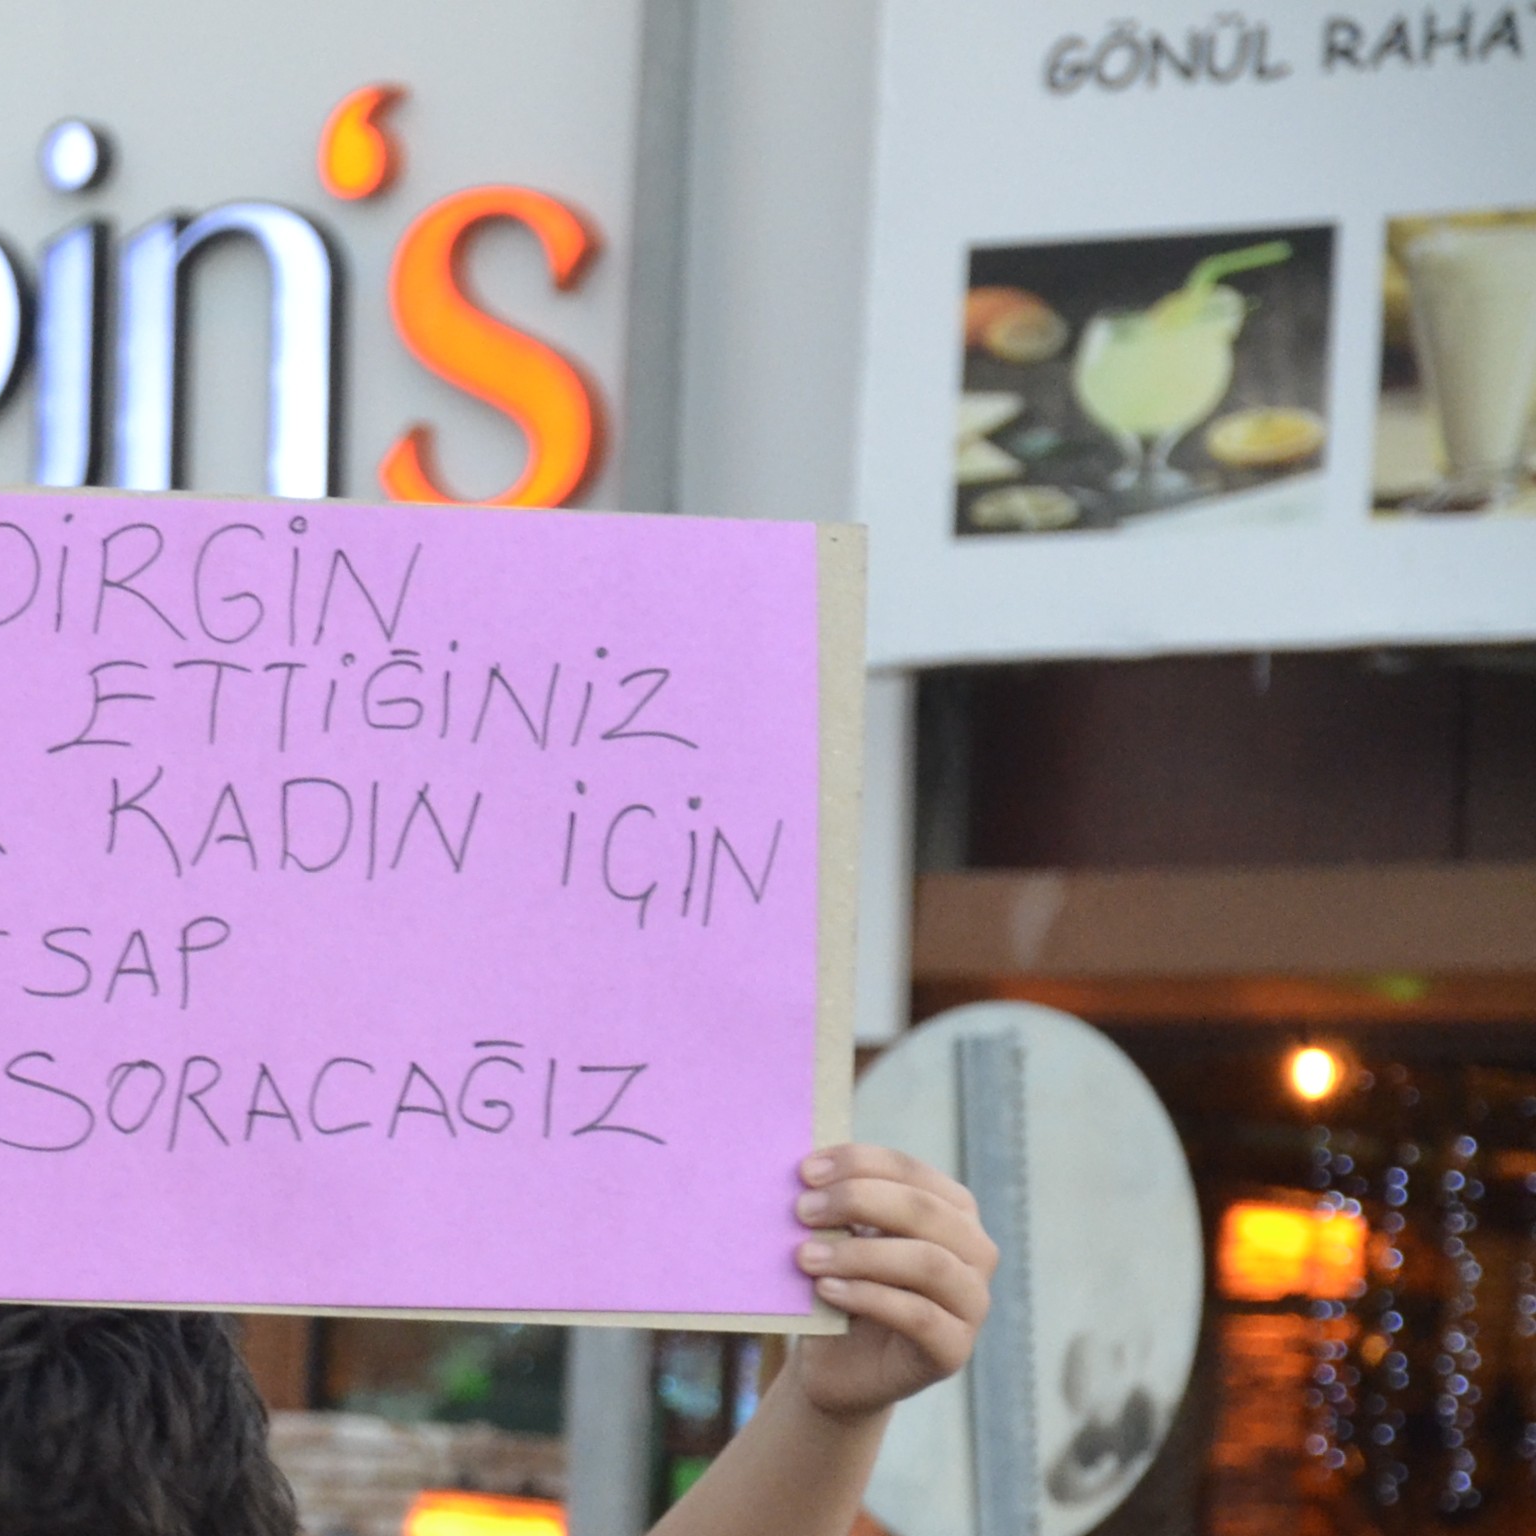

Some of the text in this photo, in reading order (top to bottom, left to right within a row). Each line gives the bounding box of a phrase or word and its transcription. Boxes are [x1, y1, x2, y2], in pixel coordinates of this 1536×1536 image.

[1044, 3, 1536, 97] GÖNÜL RAHA
[46, 640, 699, 754] ETTİĞİNİZ
[105, 765, 482, 881] KADIN
[560, 780, 784, 929] İÇİN
